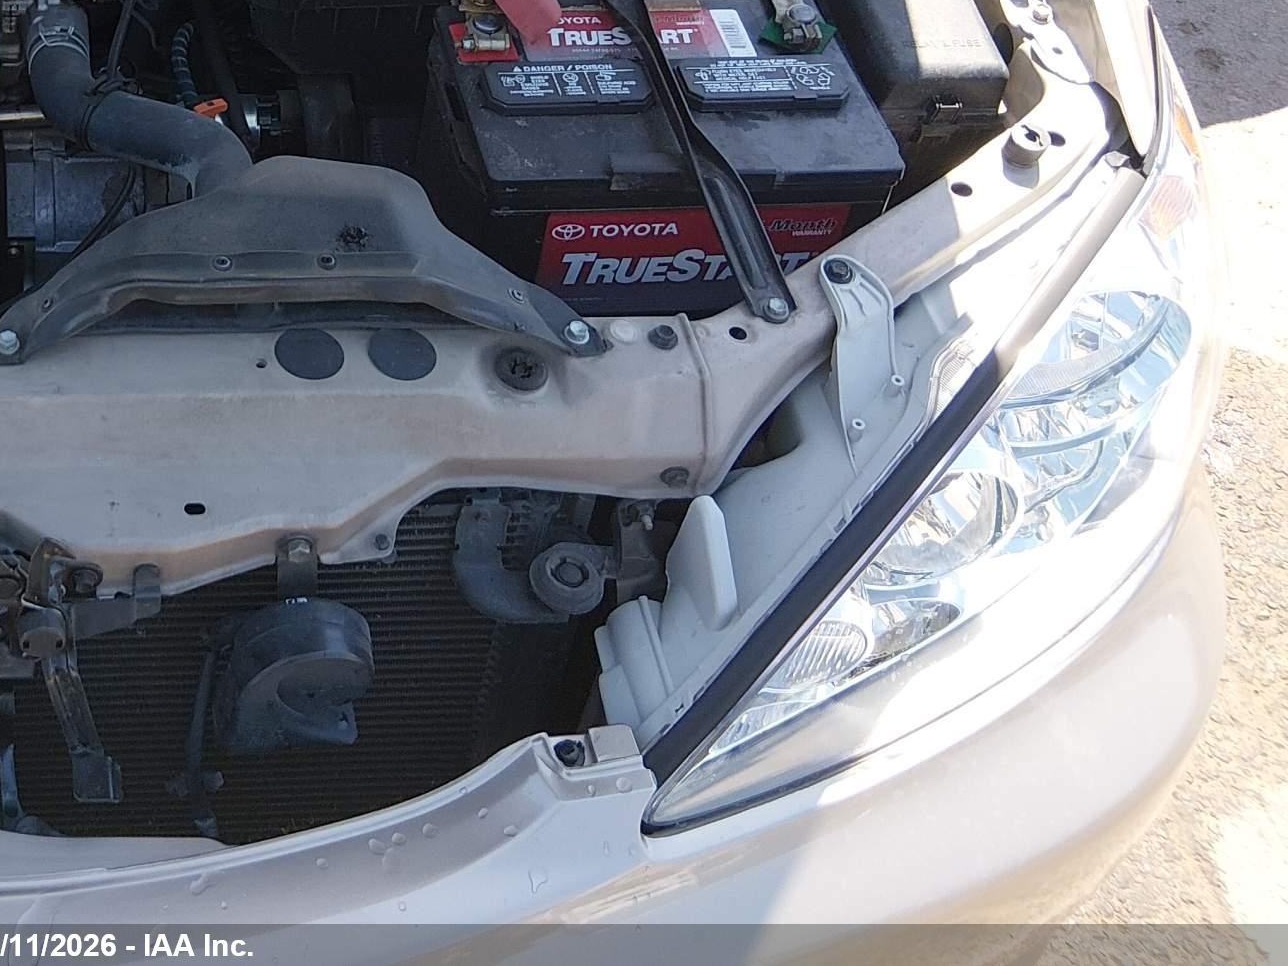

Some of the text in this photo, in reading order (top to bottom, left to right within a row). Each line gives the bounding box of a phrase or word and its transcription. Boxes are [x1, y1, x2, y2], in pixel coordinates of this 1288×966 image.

[523, 65, 565, 73] DANGER
[574, 63, 612, 71] POISON
[590, 223, 679, 237] TOYOTA
